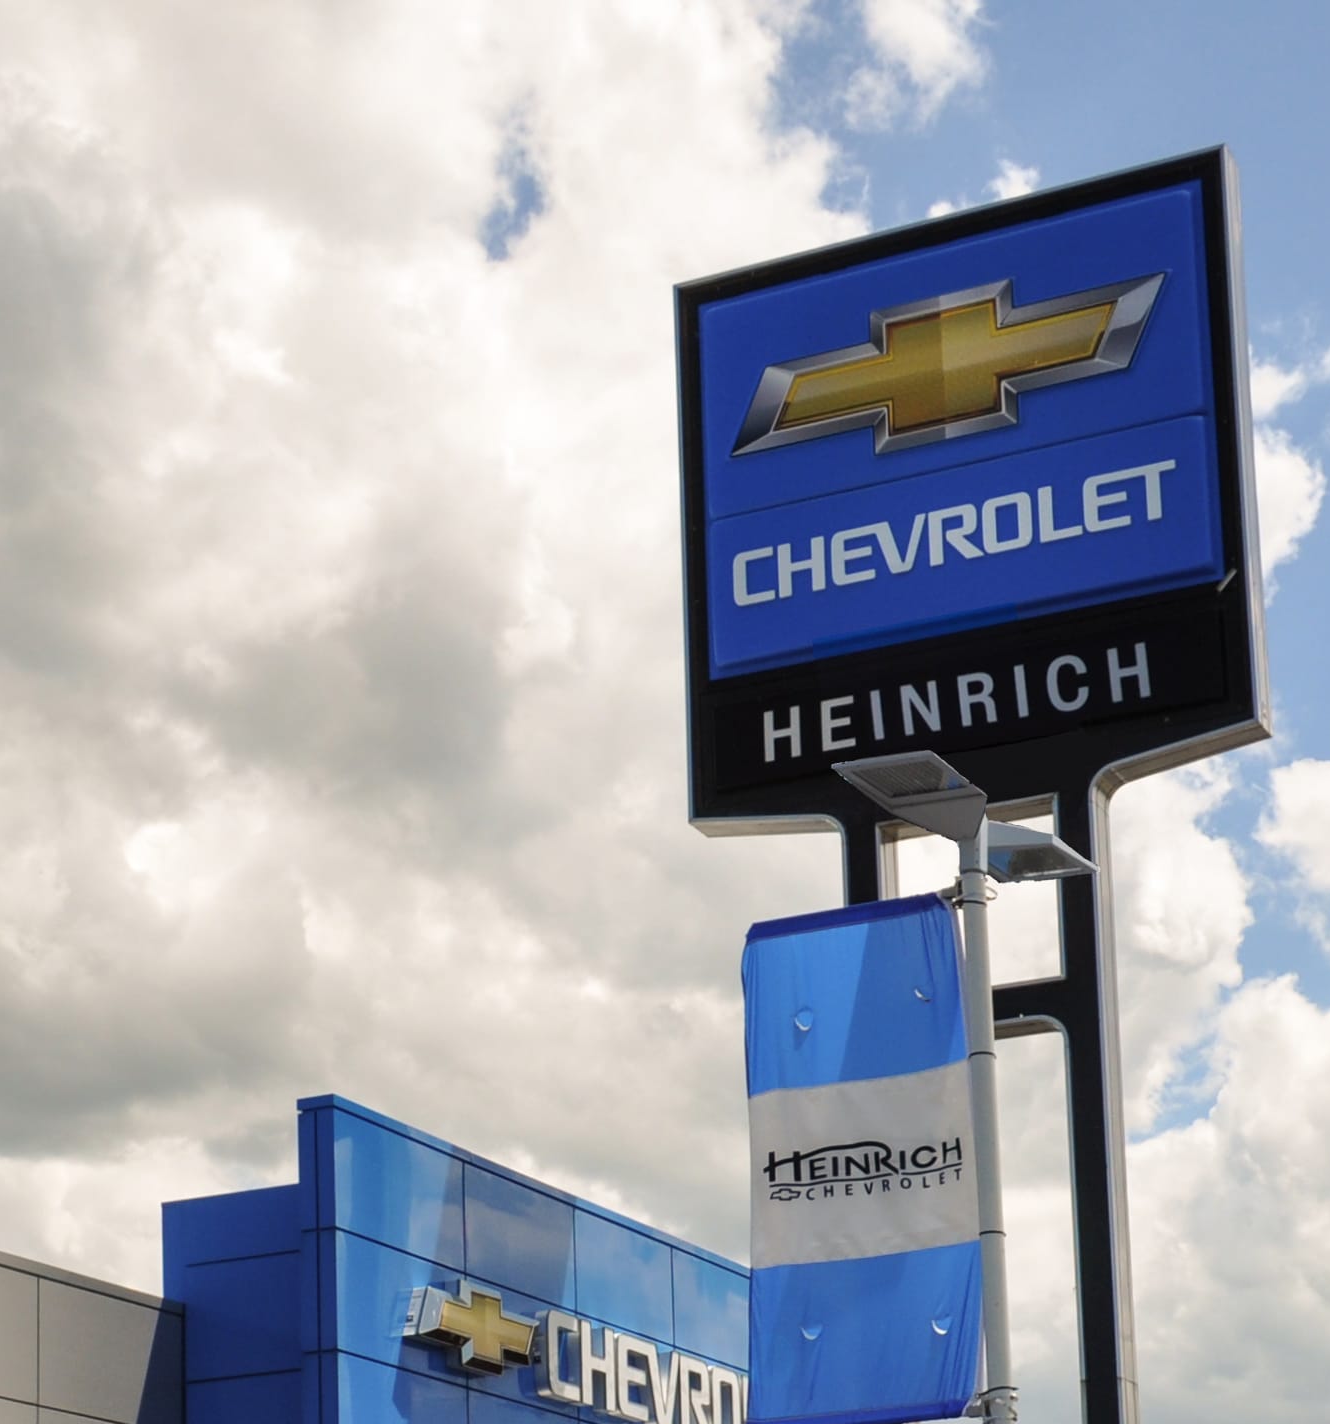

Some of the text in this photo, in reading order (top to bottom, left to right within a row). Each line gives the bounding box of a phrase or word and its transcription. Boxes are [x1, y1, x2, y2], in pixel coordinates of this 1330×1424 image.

[732, 459, 1177, 608] CHEVROLET
[762, 641, 1154, 763] HEINRICH
[763, 1137, 962, 1182] HEINRICH
[806, 1168, 962, 1201] CHEVROLET
